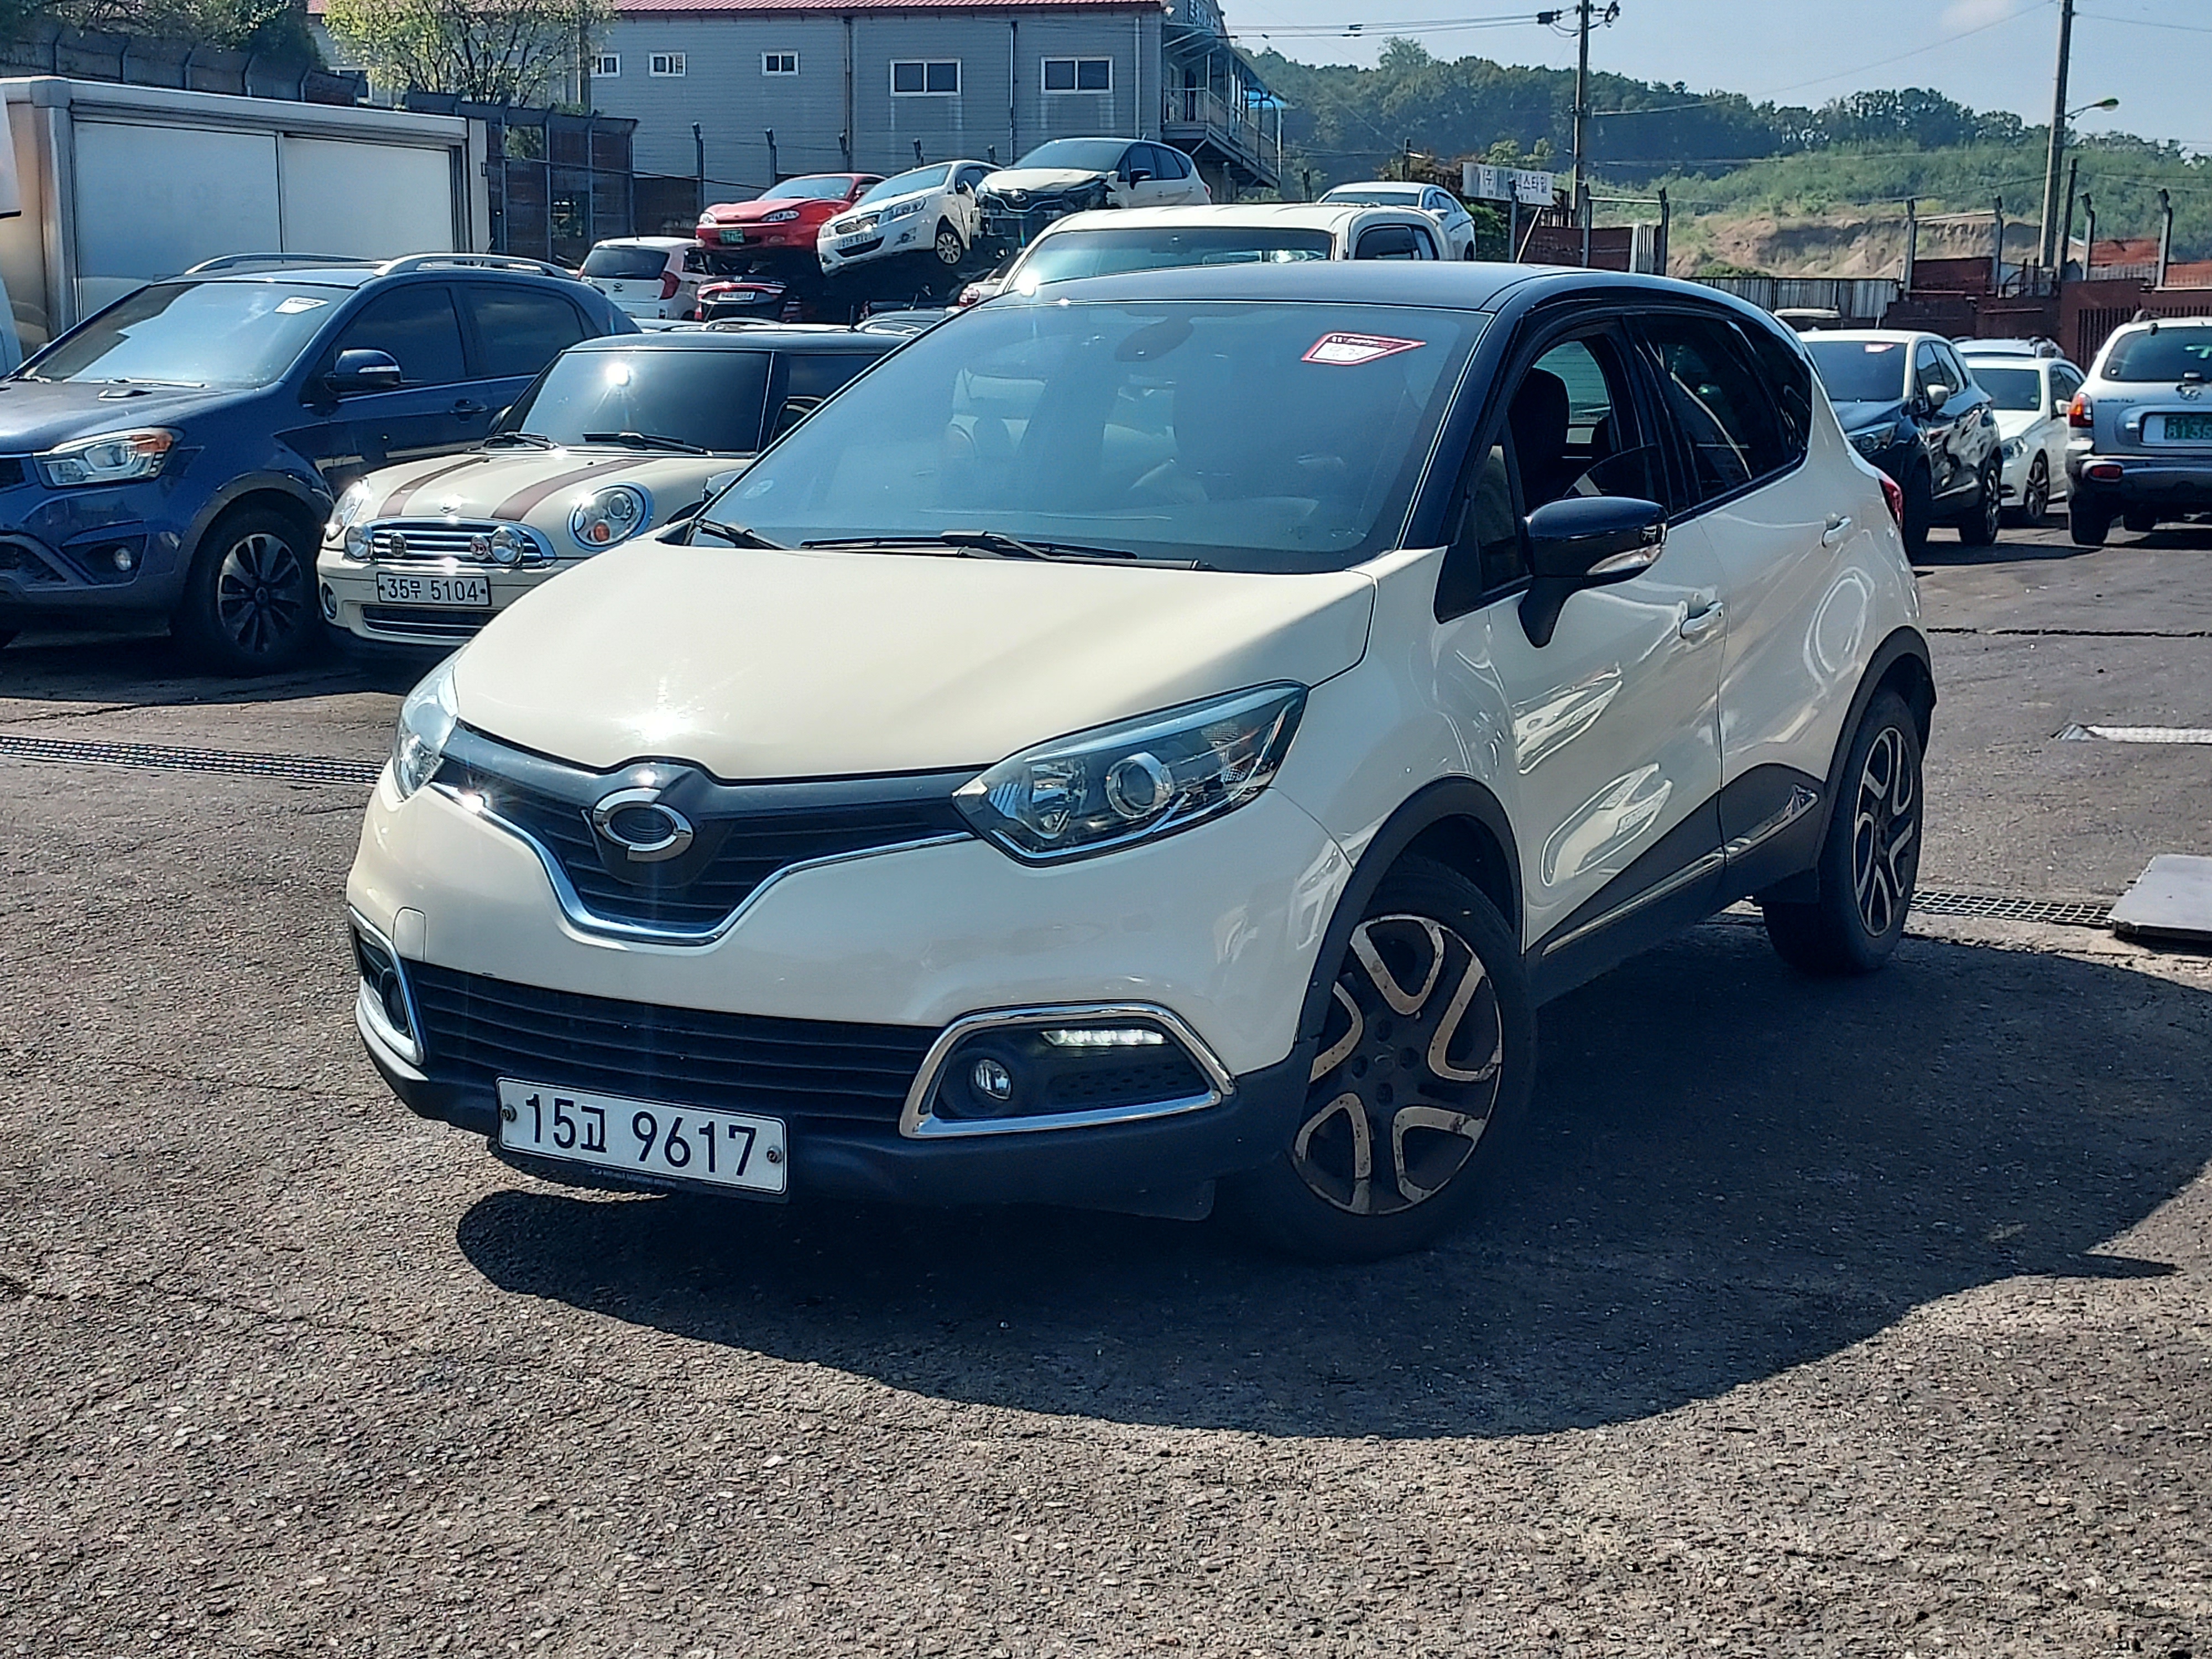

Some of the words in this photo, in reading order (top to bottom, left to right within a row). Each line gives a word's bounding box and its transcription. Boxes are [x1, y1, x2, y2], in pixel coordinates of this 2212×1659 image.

[387, 578, 421, 599] 35무
[430, 580, 479, 602] 5104
[525, 1093, 607, 1153] 15고
[631, 1110, 757, 1177] 9617
